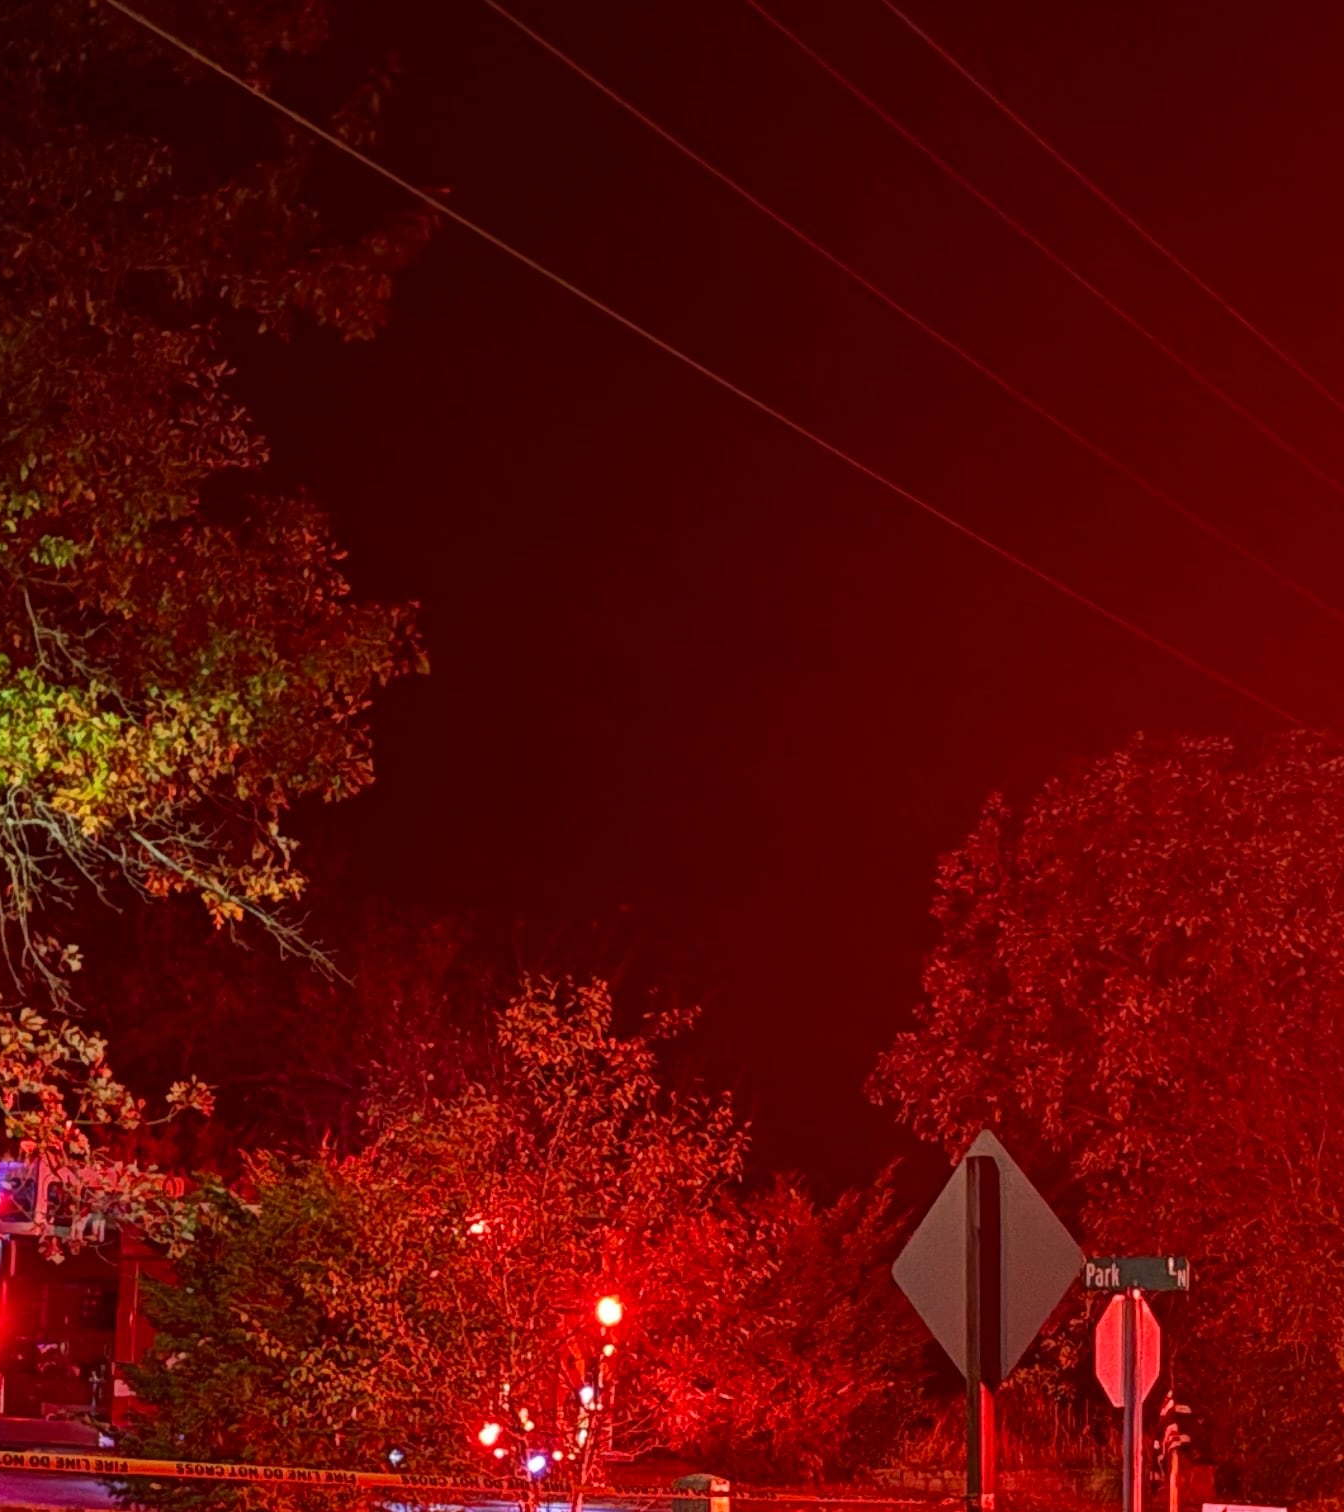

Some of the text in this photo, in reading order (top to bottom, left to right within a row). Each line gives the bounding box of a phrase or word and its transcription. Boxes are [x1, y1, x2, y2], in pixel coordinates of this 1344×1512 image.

[1086, 1262, 1120, 1288] Park
[29, 1455, 50, 1469] DO
[56, 1456, 91, 1471] LINE
[94, 1459, 129, 1473] FIRE
[176, 1463, 357, 1485] FIRE LINE DO NOT CROSS
